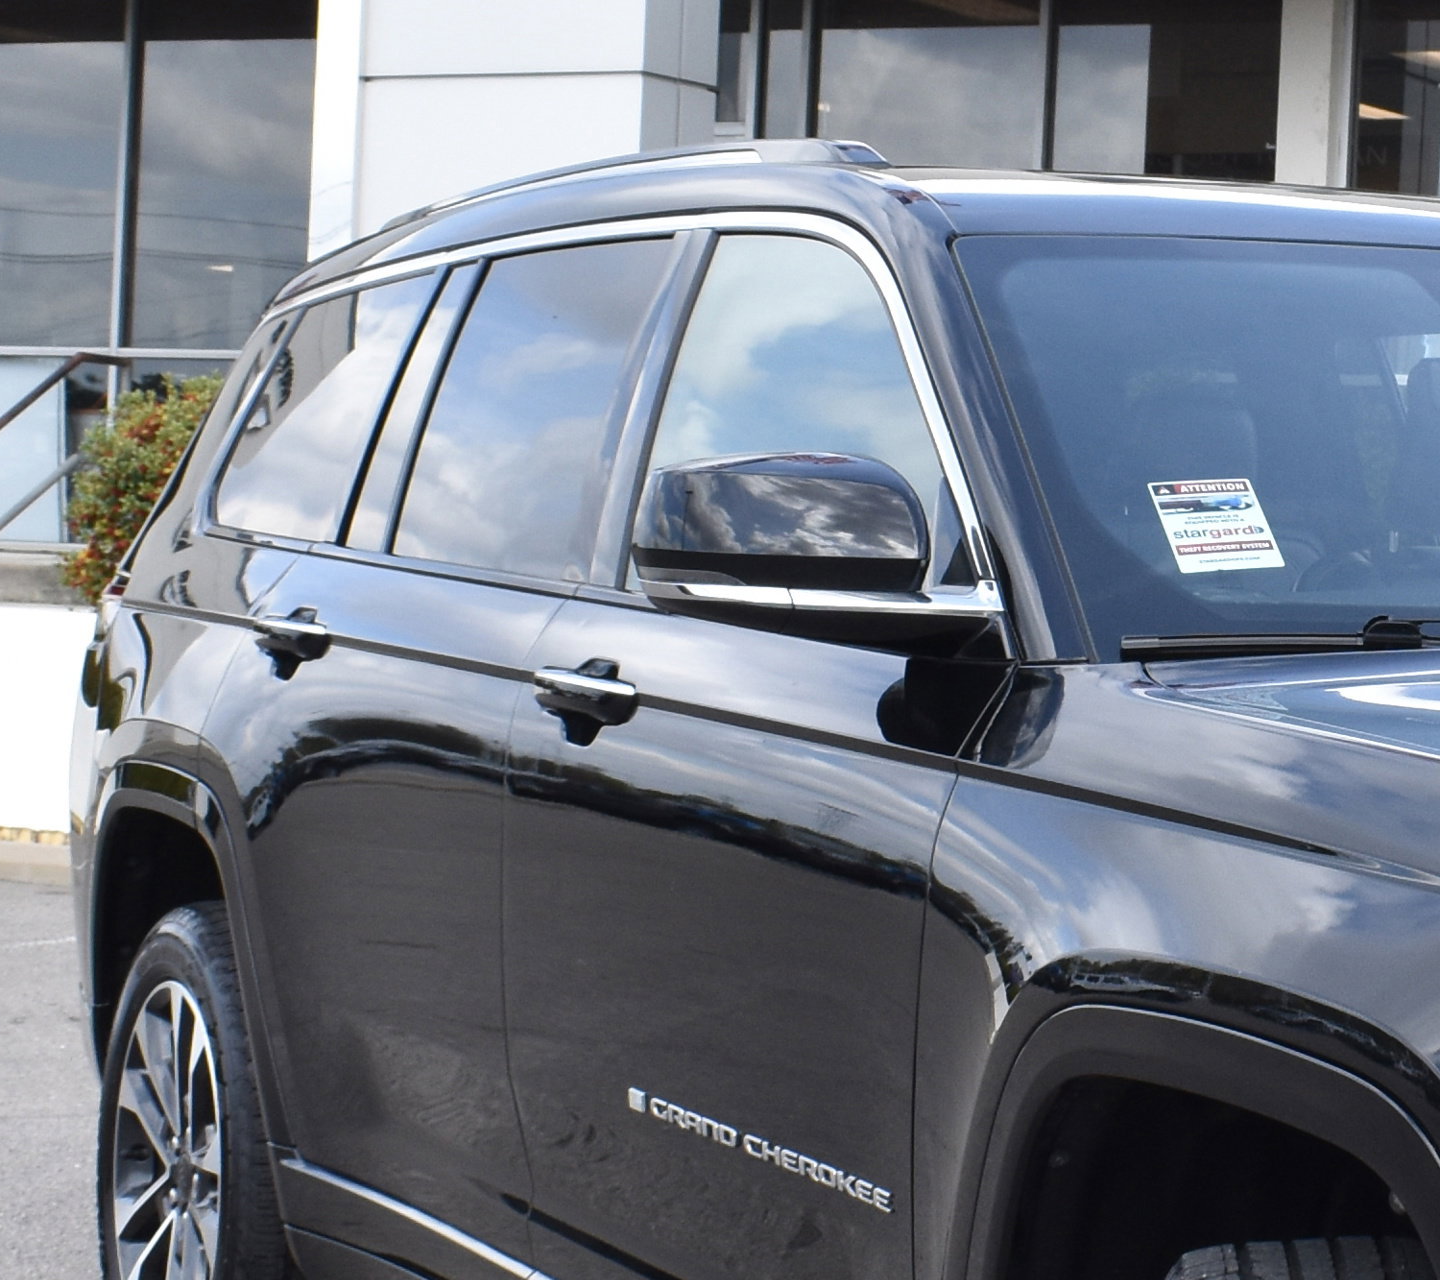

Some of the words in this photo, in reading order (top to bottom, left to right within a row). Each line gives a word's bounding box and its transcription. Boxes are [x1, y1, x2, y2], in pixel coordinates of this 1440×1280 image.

[1180, 482, 1245, 494] ATTENTION
[1173, 525, 1254, 539] stargard
[649, 1097, 739, 1148] GRAND
[742, 1133, 893, 1213] CHEROKEE
